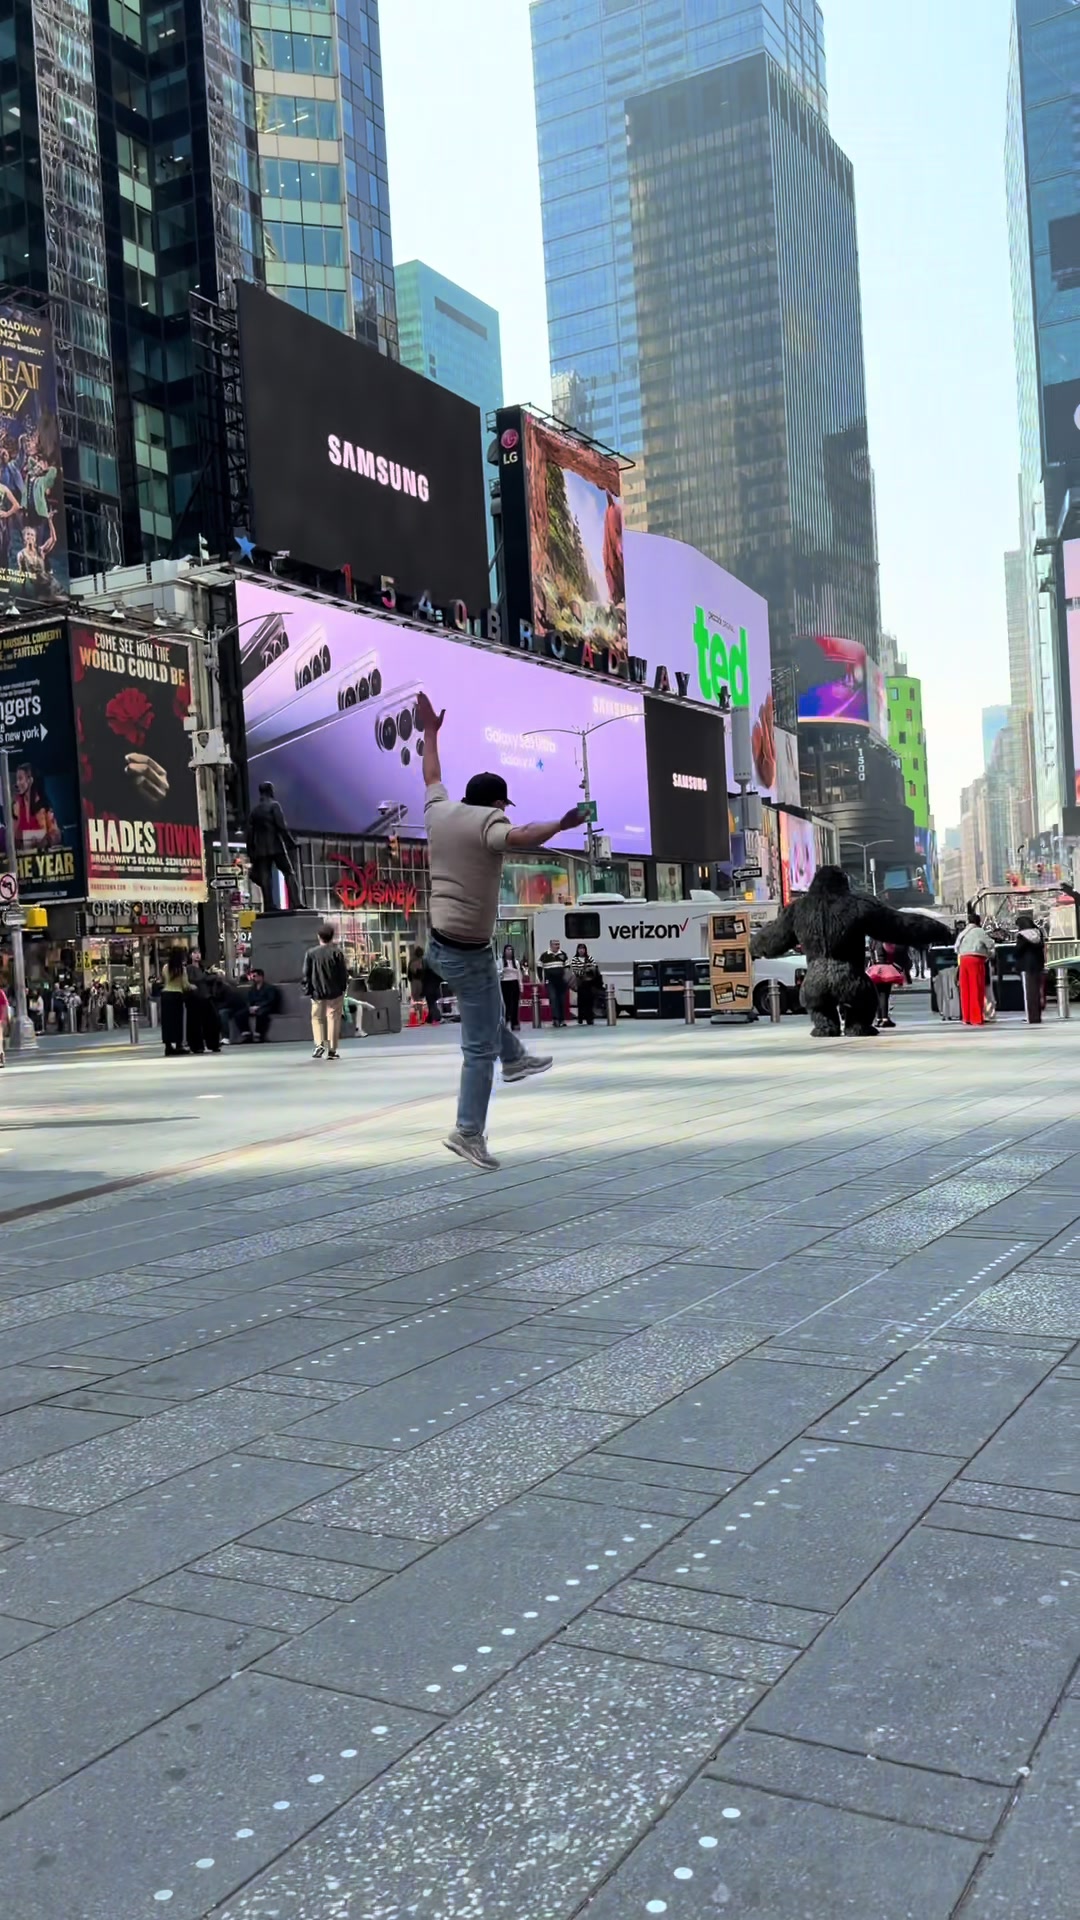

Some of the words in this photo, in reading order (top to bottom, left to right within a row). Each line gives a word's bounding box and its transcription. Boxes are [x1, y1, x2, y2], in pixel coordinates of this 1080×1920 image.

[327, 433, 431, 503] SAMSUNG
[503, 451, 519, 466] LG
[340, 562, 468, 631] 1540
[484, 605, 691, 697] BROADWAY
[94, 631, 118, 652] COME
[119, 637, 135, 656] SEE
[136, 640, 153, 660] HOW
[154, 644, 171, 664] THE
[692, 603, 750, 708] ted
[79, 645, 126, 675] WORLD
[128, 656, 169, 684] COULD
[170, 666, 186, 687] BE
[5, 731, 21, 743] new
[22, 725, 40, 742] york
[484, 726, 519, 750] Galaxy
[672, 772, 708, 792] SAMSUNG
[87, 818, 202, 857] HADESTOWN
[35, 852, 75, 878] YEAR
[138, 857, 164, 867] GLOBAL
[91, 901, 132, 917] GIFTS
[160, 925, 181, 933] SONY
[608, 920, 680, 940] verizon
